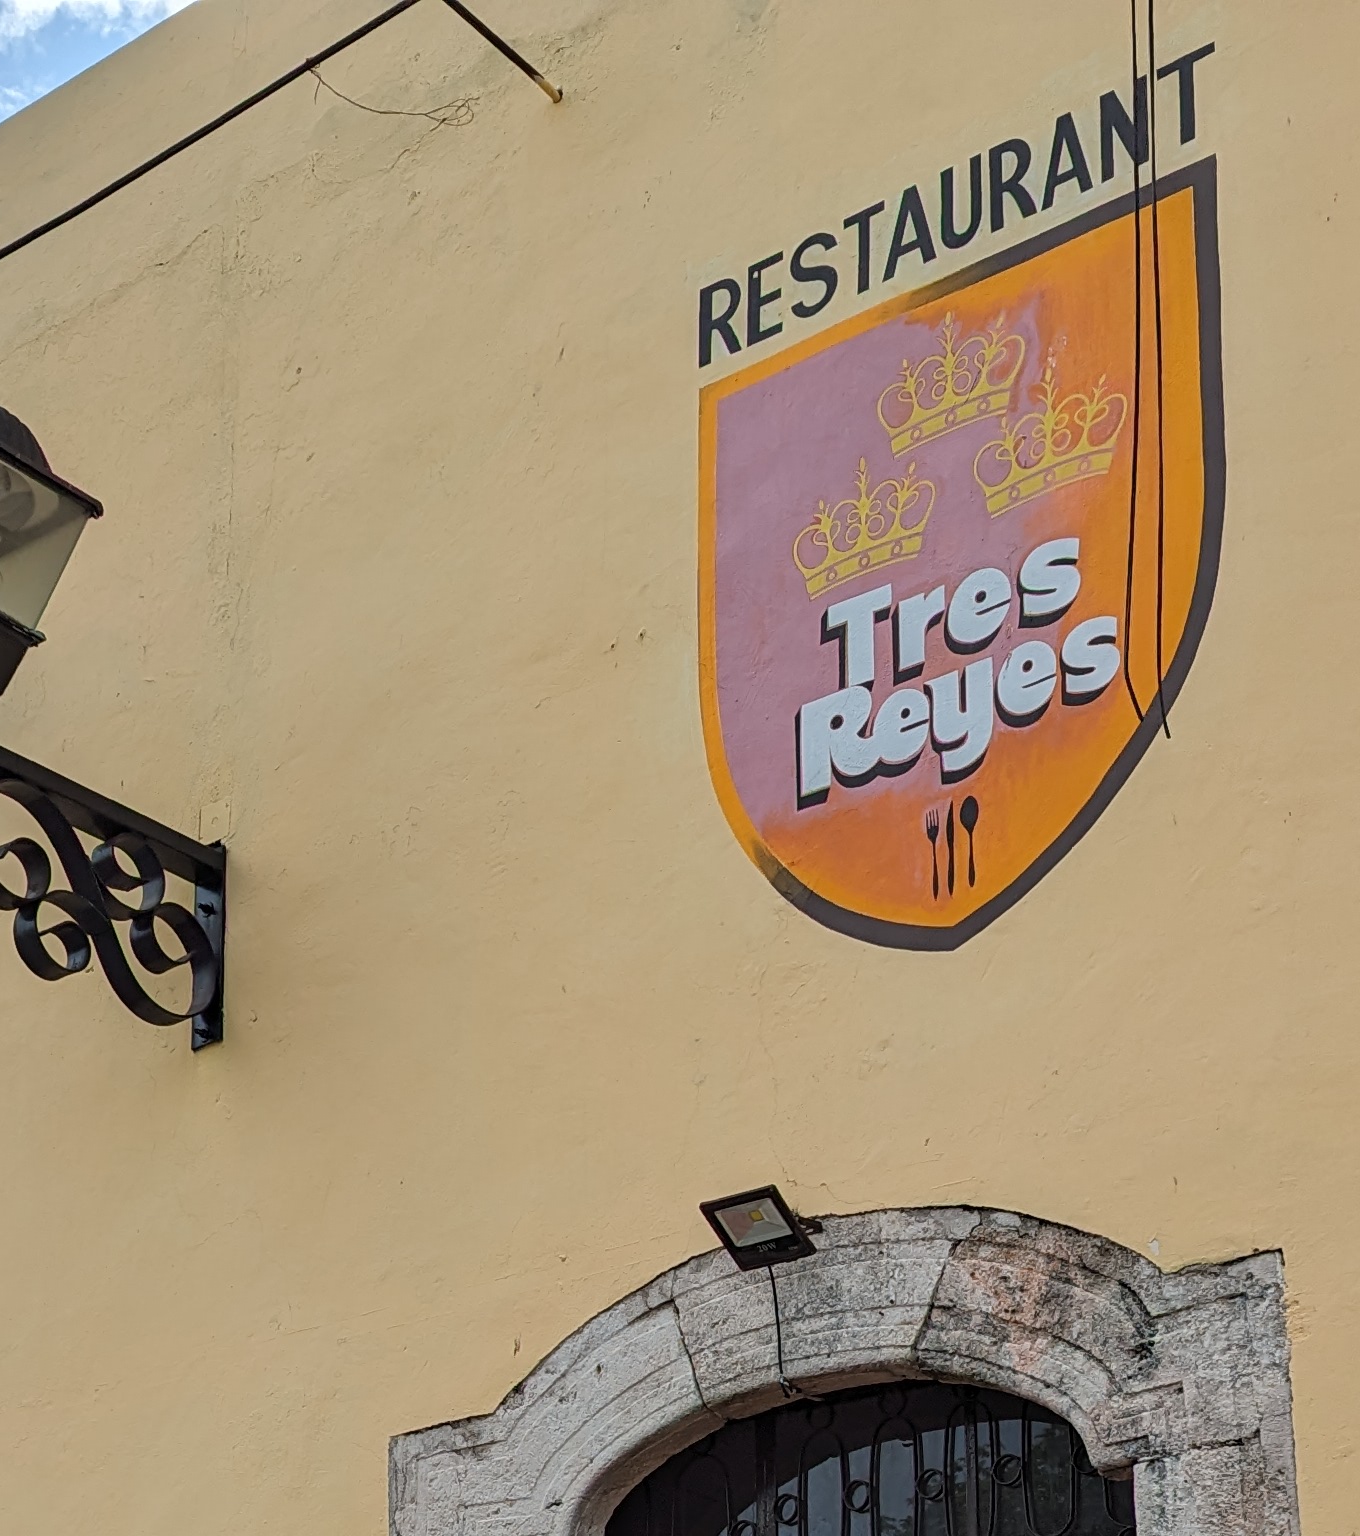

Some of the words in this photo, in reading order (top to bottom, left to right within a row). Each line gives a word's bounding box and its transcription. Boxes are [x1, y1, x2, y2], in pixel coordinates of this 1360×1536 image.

[698, 42, 1215, 367] RESTAURANT
[821, 537, 1080, 686] Tres
[797, 615, 1121, 810] Reyes
